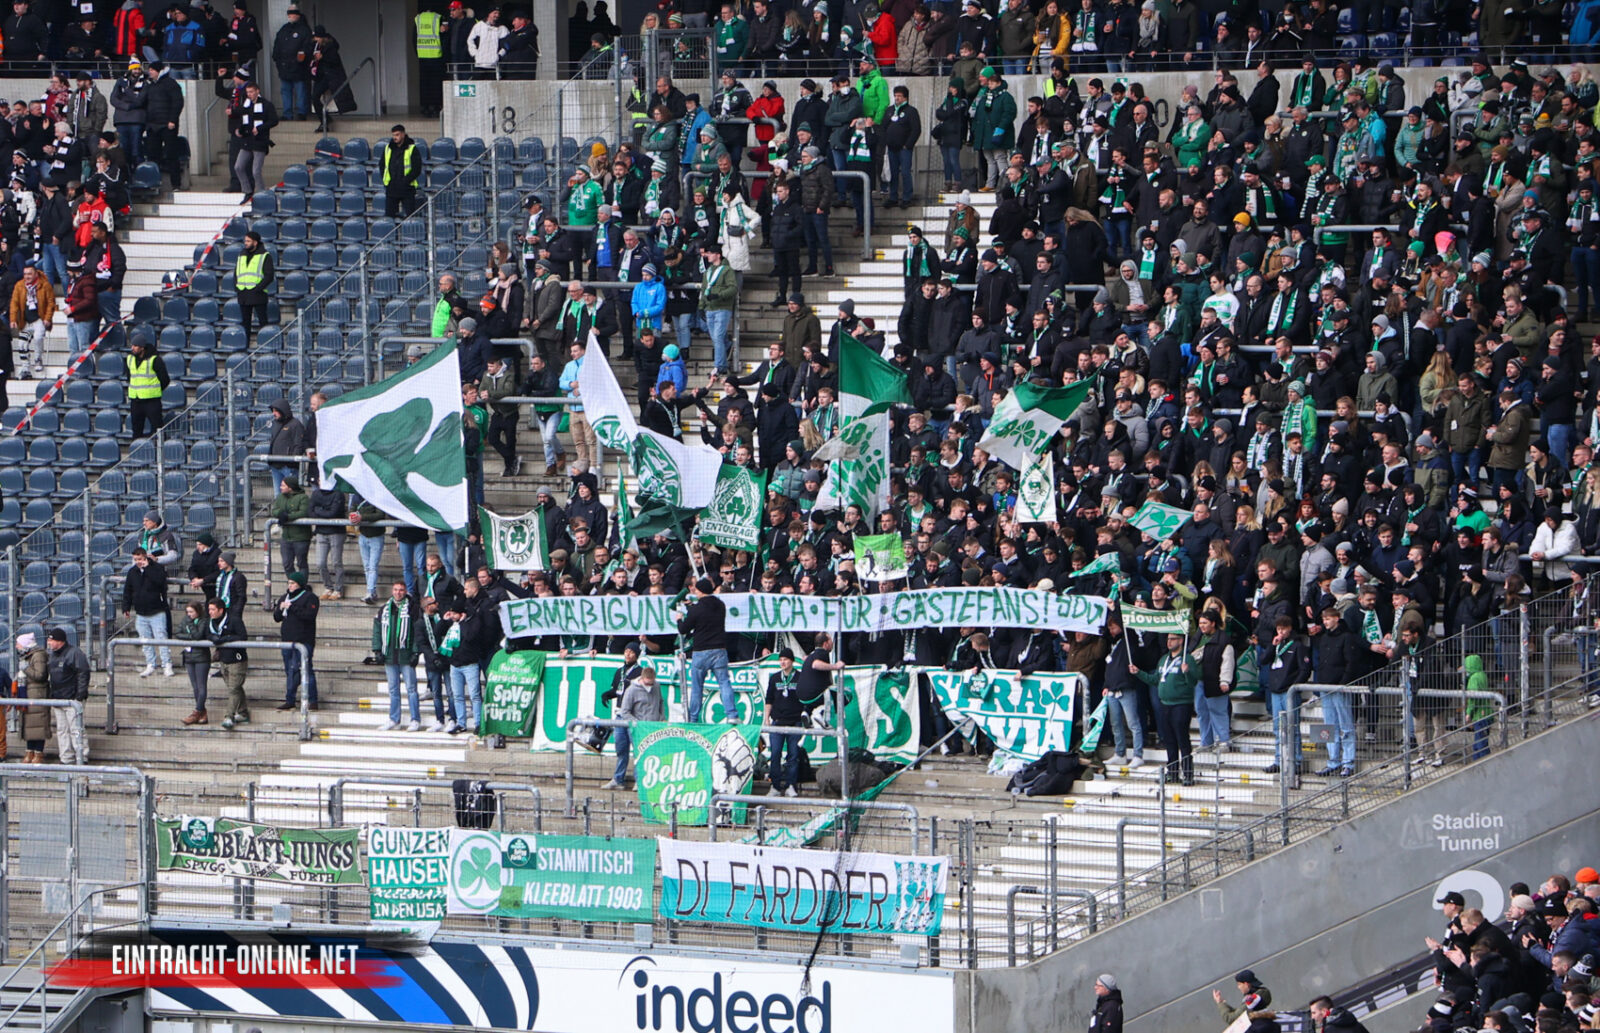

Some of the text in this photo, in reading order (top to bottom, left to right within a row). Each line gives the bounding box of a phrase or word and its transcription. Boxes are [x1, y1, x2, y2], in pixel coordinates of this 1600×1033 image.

[488, 106, 516, 134] 18
[706, 521, 754, 538] ENTOURAGE
[715, 536, 746, 548] ULTRAS
[748, 594, 808, 629] AUCH
[822, 597, 872, 629] FÜR
[493, 684, 537, 709] SpVg
[484, 703, 522, 722] Fürth
[643, 751, 698, 789] Bella
[1432, 812, 1504, 831] Stadion
[371, 829, 450, 855] GUNZEN
[1437, 833, 1499, 852] Tunnel
[184, 859, 226, 873] SPVGG
[371, 858, 450, 885] HAUSEN
[538, 847, 634, 876] STAMMTISCH
[290, 868, 336, 884] FÜRTH
[522, 881, 643, 911] KLEEBLATT 1903
[675, 850, 890, 930] DI FÄRDDER
[633, 968, 831, 1033] indeed
